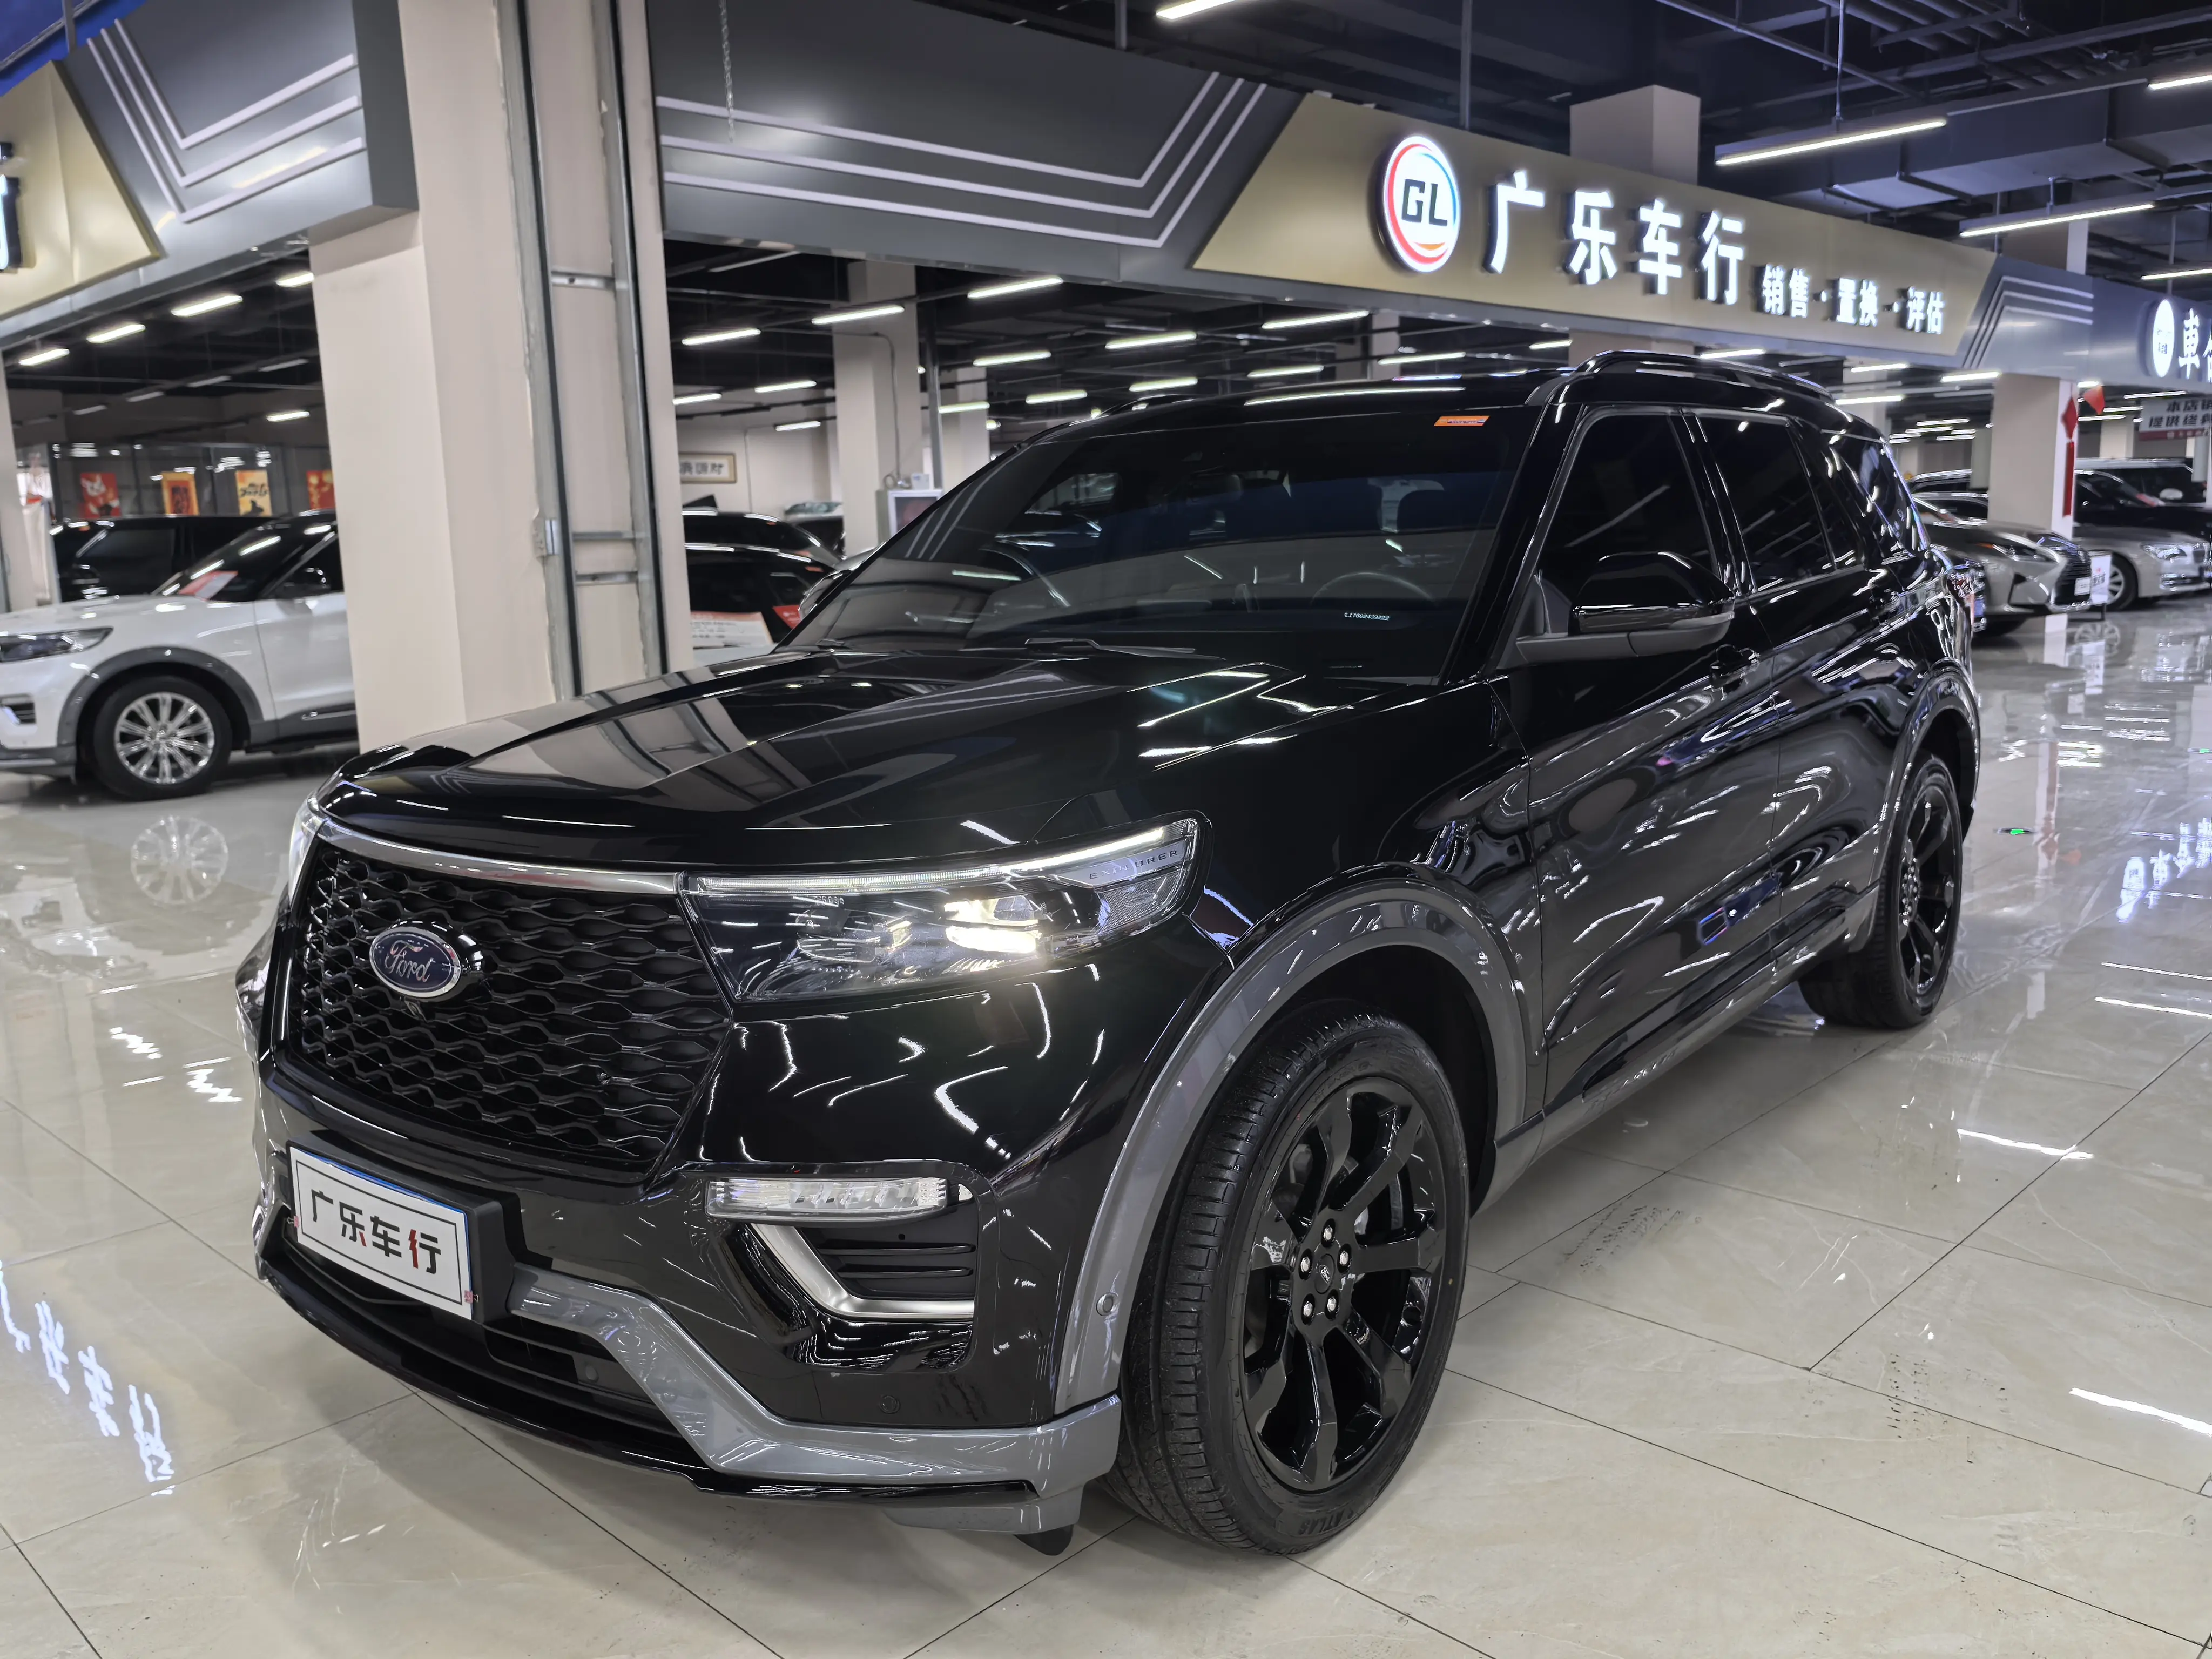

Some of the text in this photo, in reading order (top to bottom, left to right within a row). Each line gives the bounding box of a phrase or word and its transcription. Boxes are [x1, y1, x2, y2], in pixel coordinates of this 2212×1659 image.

[1401, 178, 1448, 227] GL
[1490, 169, 1745, 306] 广乐车行
[1089, 849, 1178, 880] EXPLORER
[384, 940, 434, 983] Ford
[311, 1189, 441, 1274] 广乐车行
[1321, 1267, 1331, 1282] Ford
